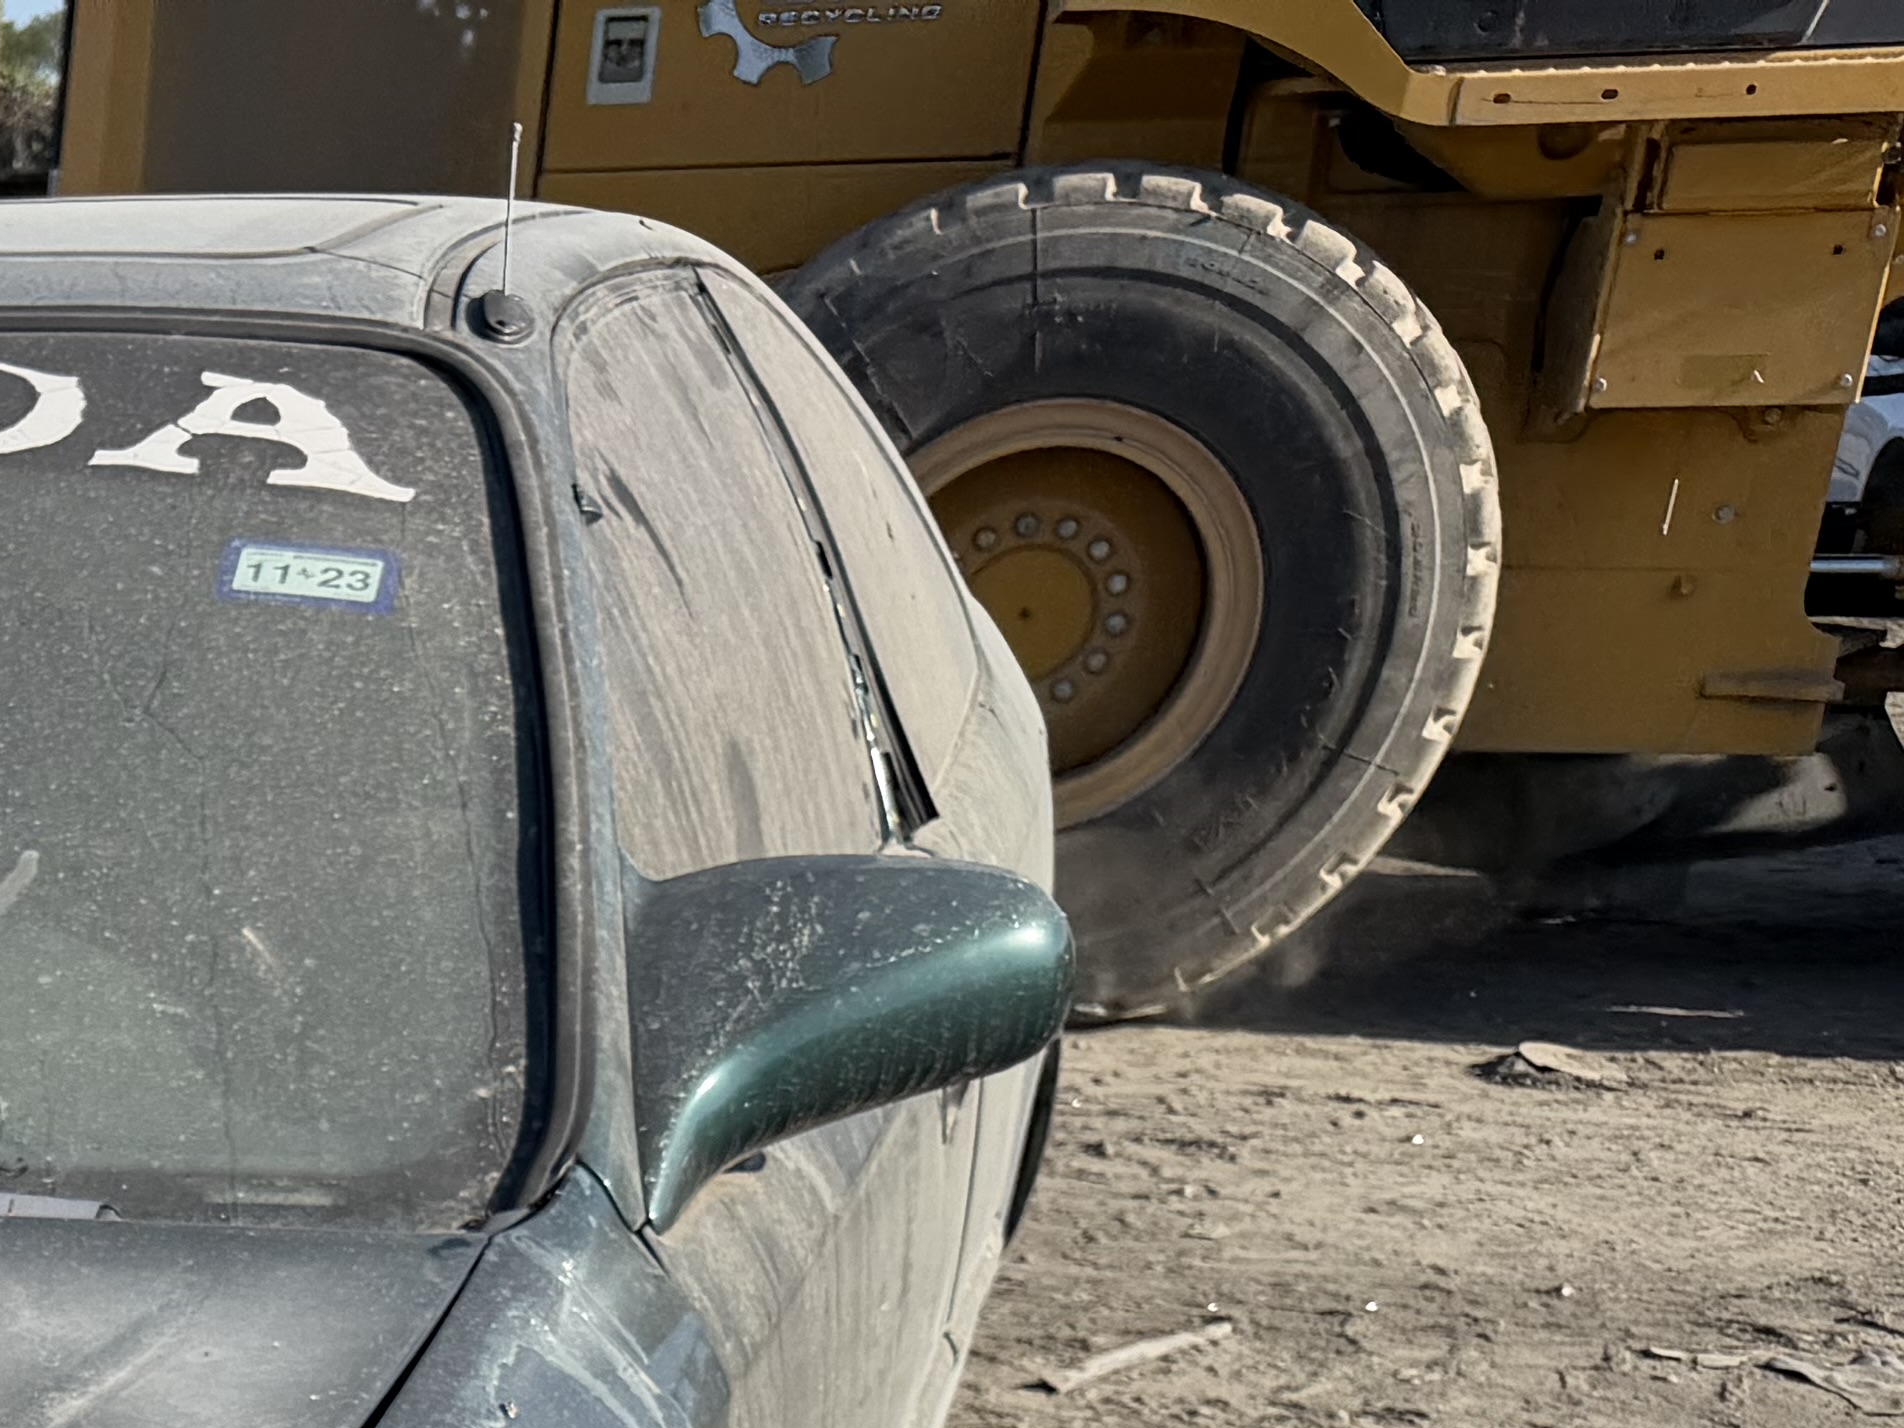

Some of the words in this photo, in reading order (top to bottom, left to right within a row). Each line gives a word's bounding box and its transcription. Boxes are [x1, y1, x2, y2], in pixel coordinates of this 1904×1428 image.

[757, 4, 942, 26] RECYCLING
[247, 561, 291, 585] 11
[317, 567, 371, 592] 23
